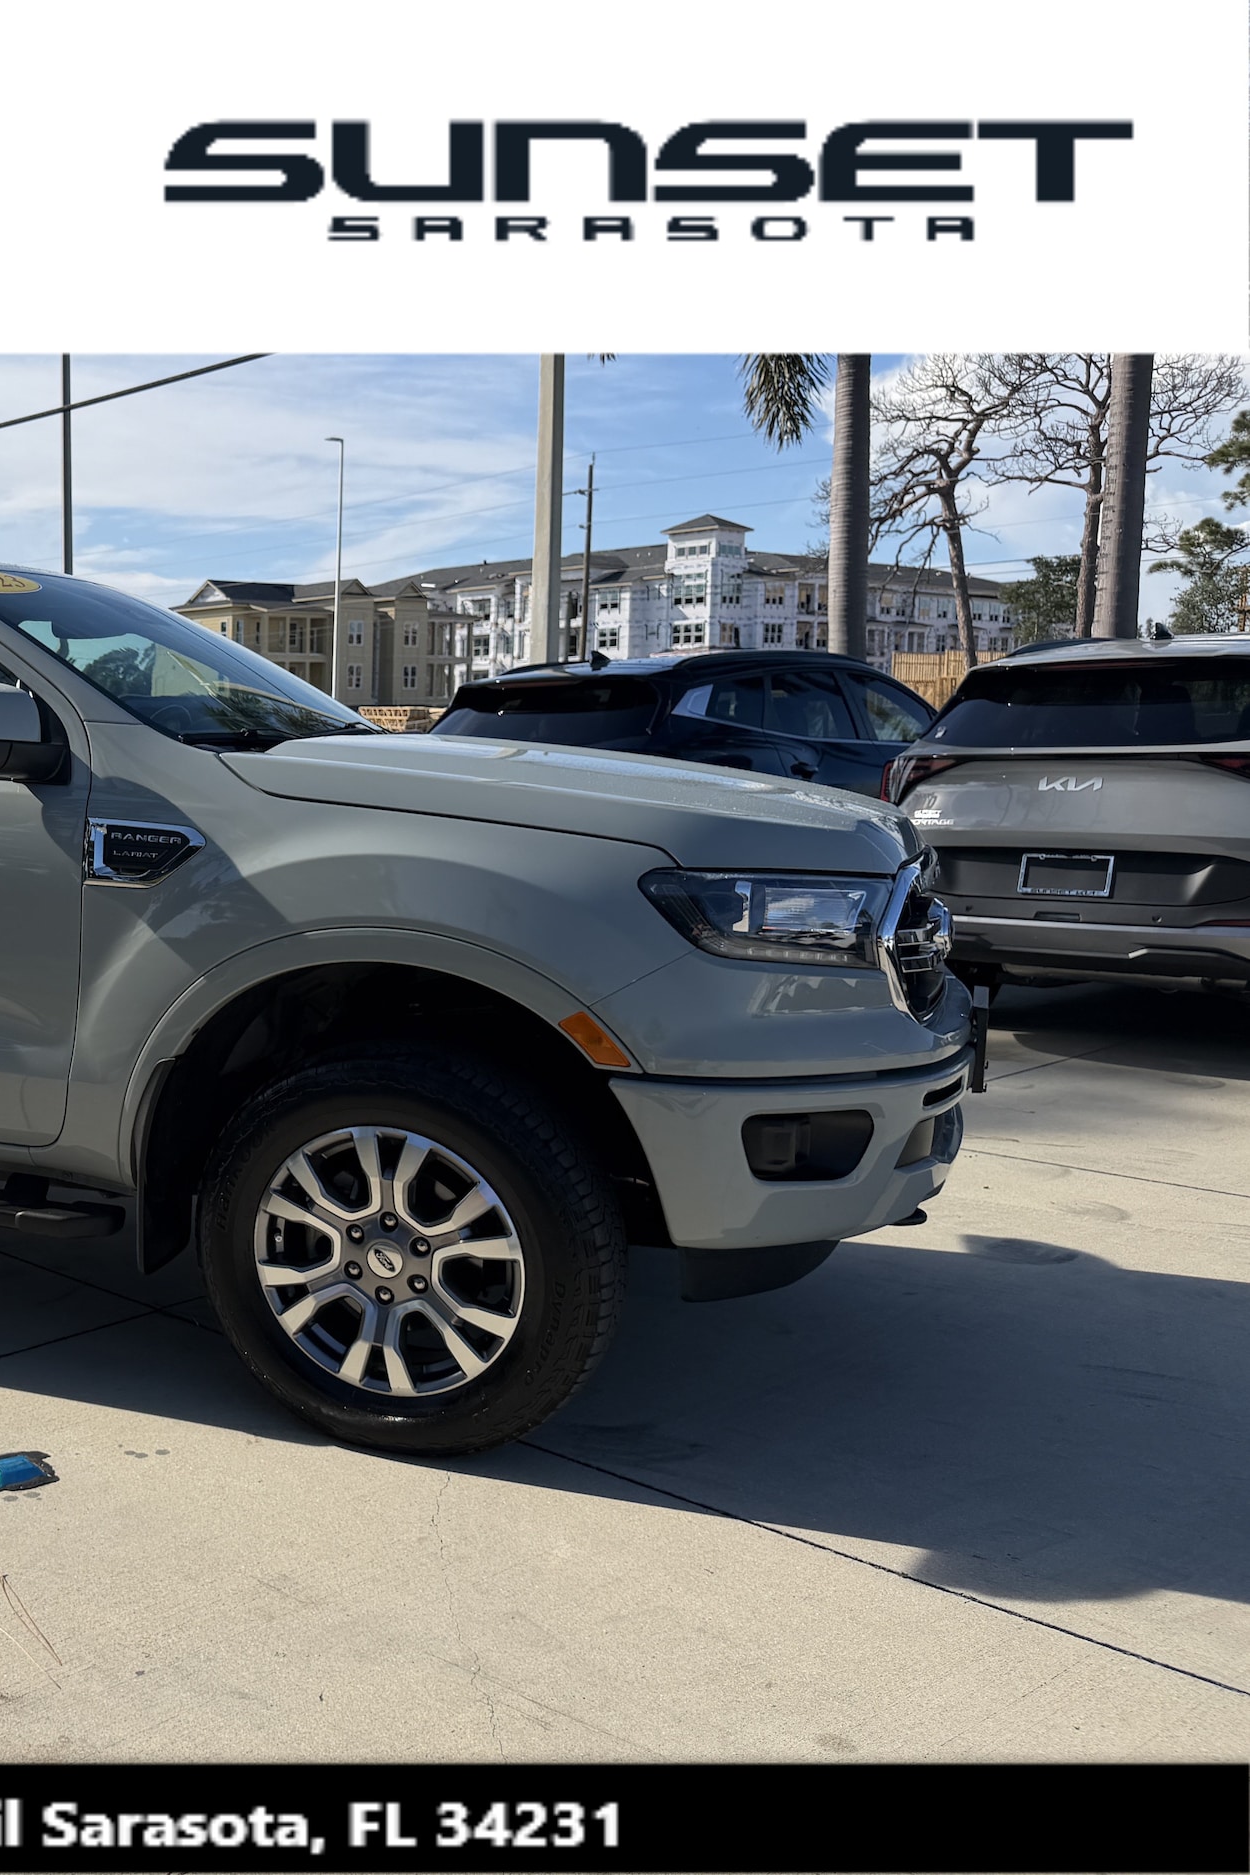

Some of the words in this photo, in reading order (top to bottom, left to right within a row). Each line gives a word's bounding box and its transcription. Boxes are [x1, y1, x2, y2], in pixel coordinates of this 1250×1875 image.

[1038, 776, 1103, 791] KIA
[111, 832, 181, 844] RANGER
[113, 850, 159, 859] LARIAT
